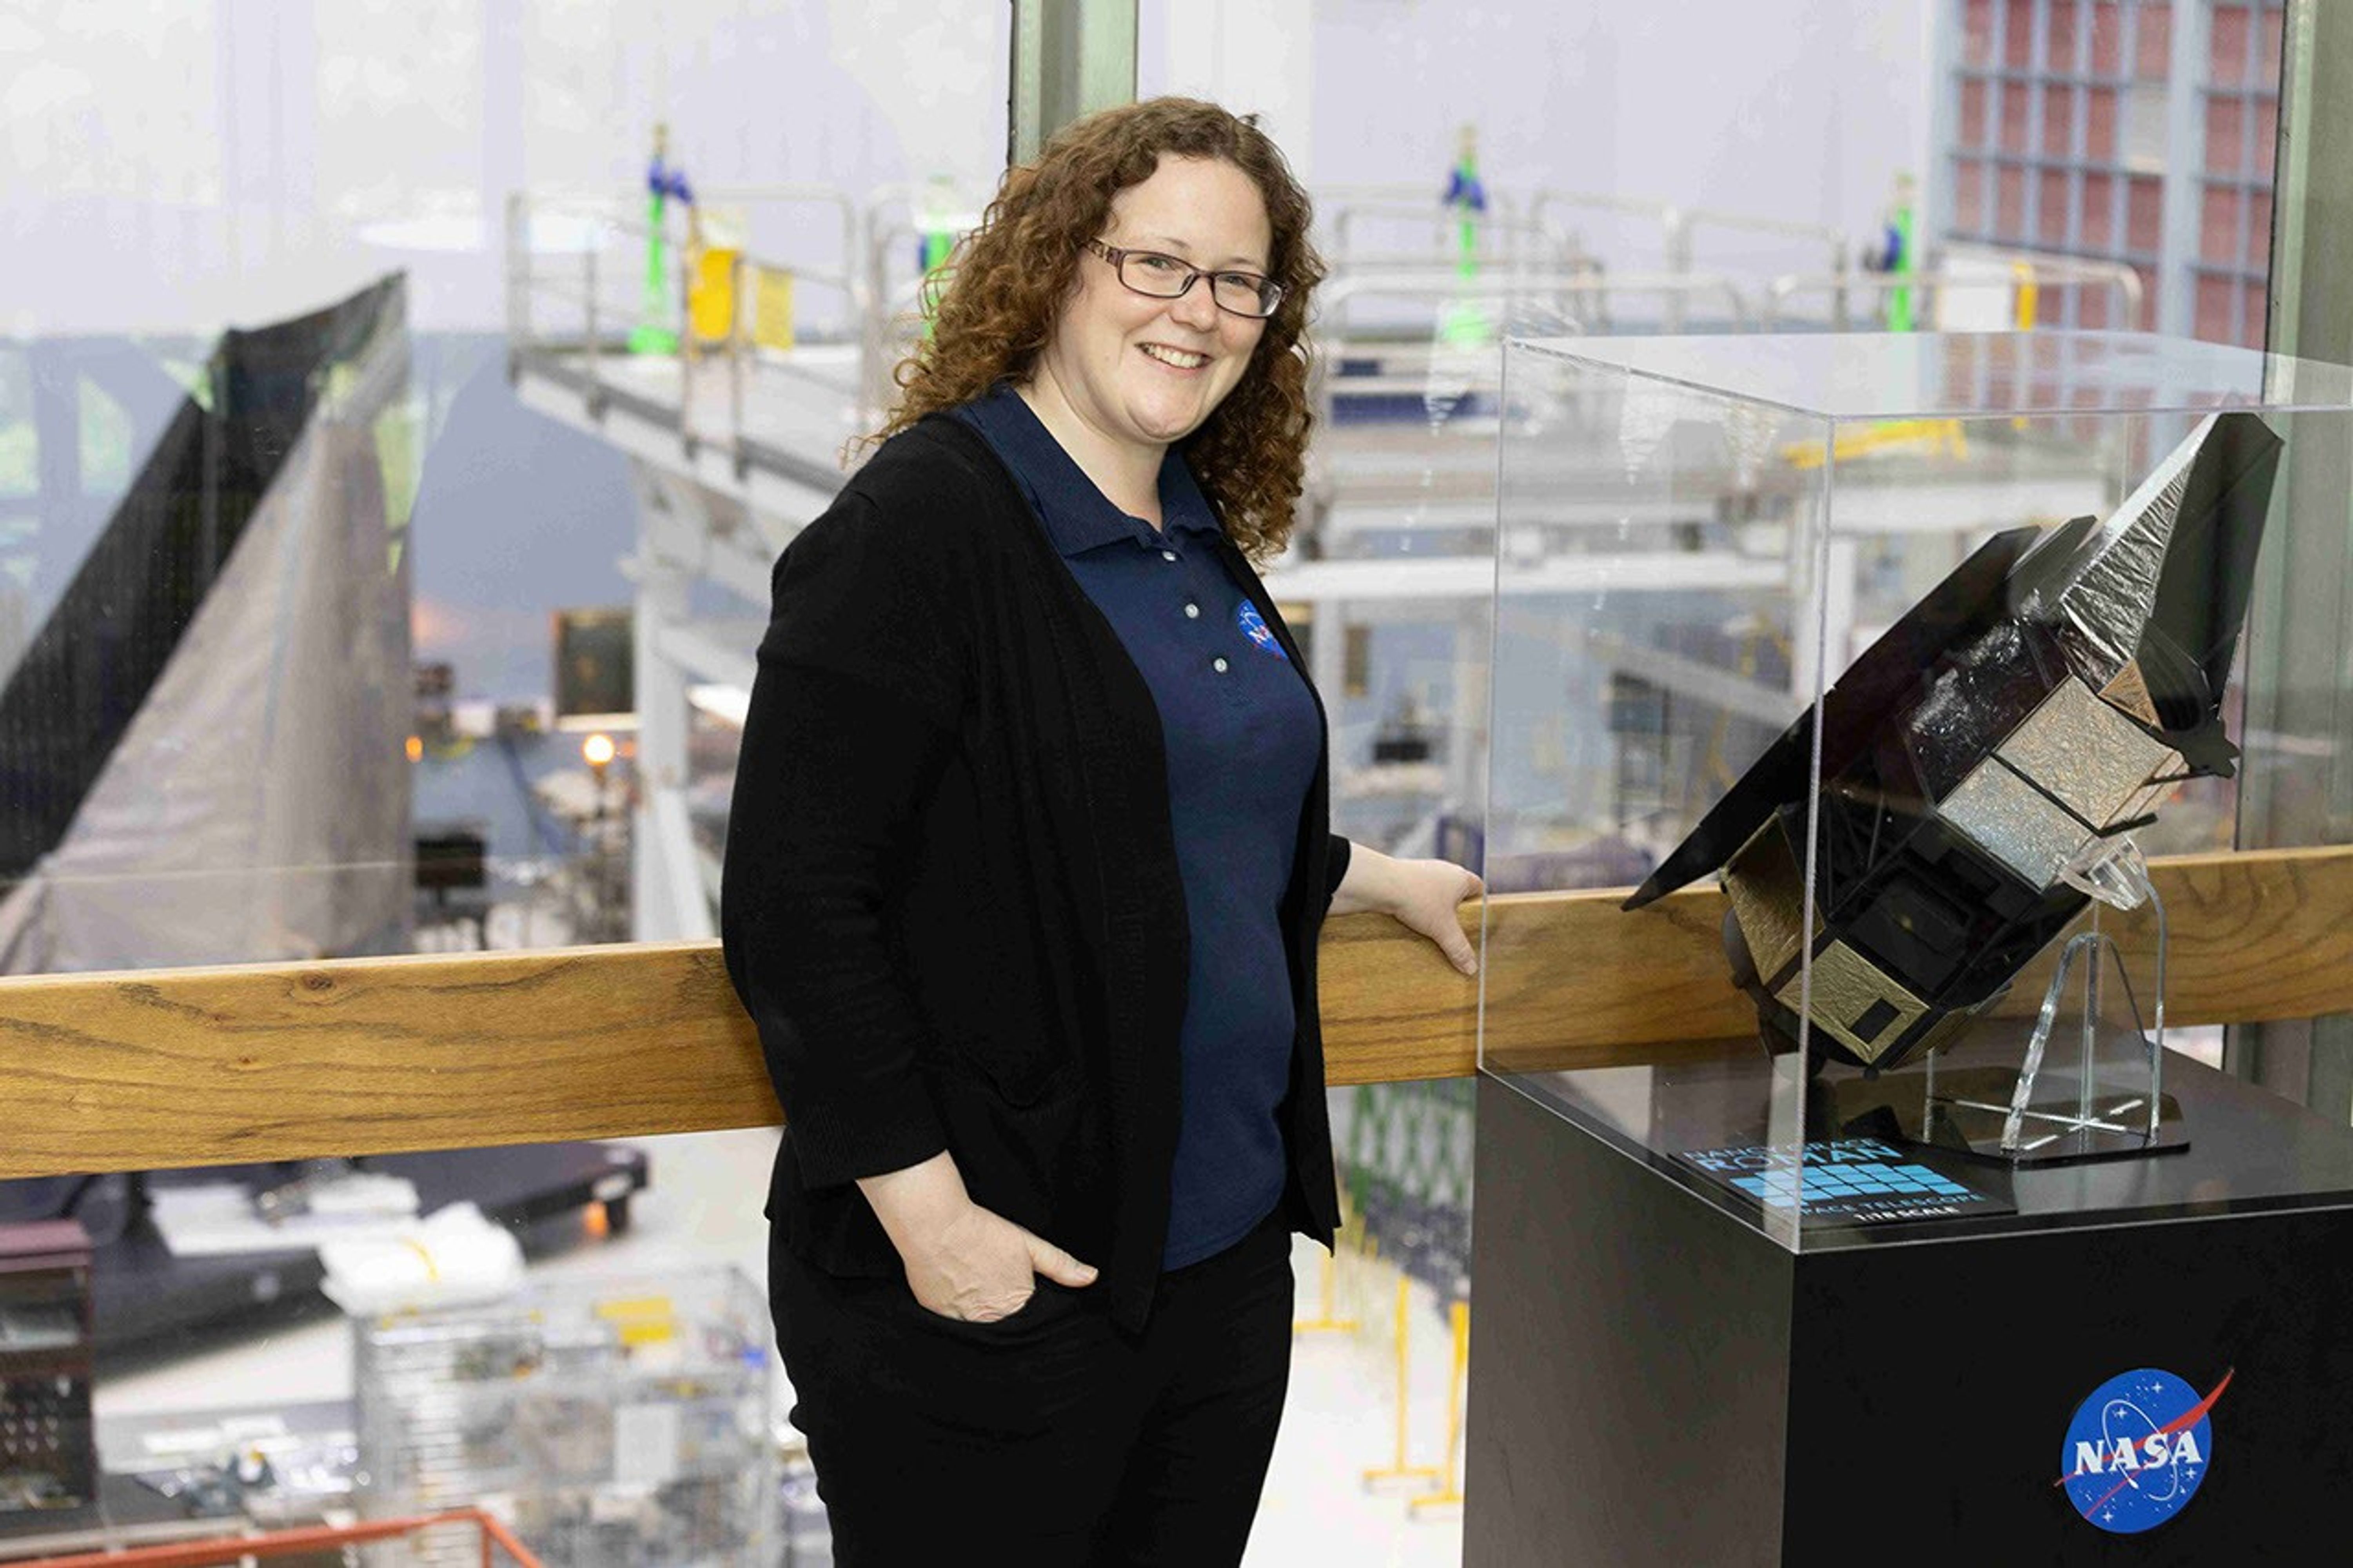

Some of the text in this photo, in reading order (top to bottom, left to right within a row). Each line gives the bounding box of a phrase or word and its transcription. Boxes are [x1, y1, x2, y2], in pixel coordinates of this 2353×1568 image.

[1696, 1145, 1903, 1171] ROMAN
[1786, 1194, 1986, 1214] PACE TELESCOPE
[1897, 1206, 1960, 1218] SCALE
[2074, 1429, 2202, 1475] NASA
